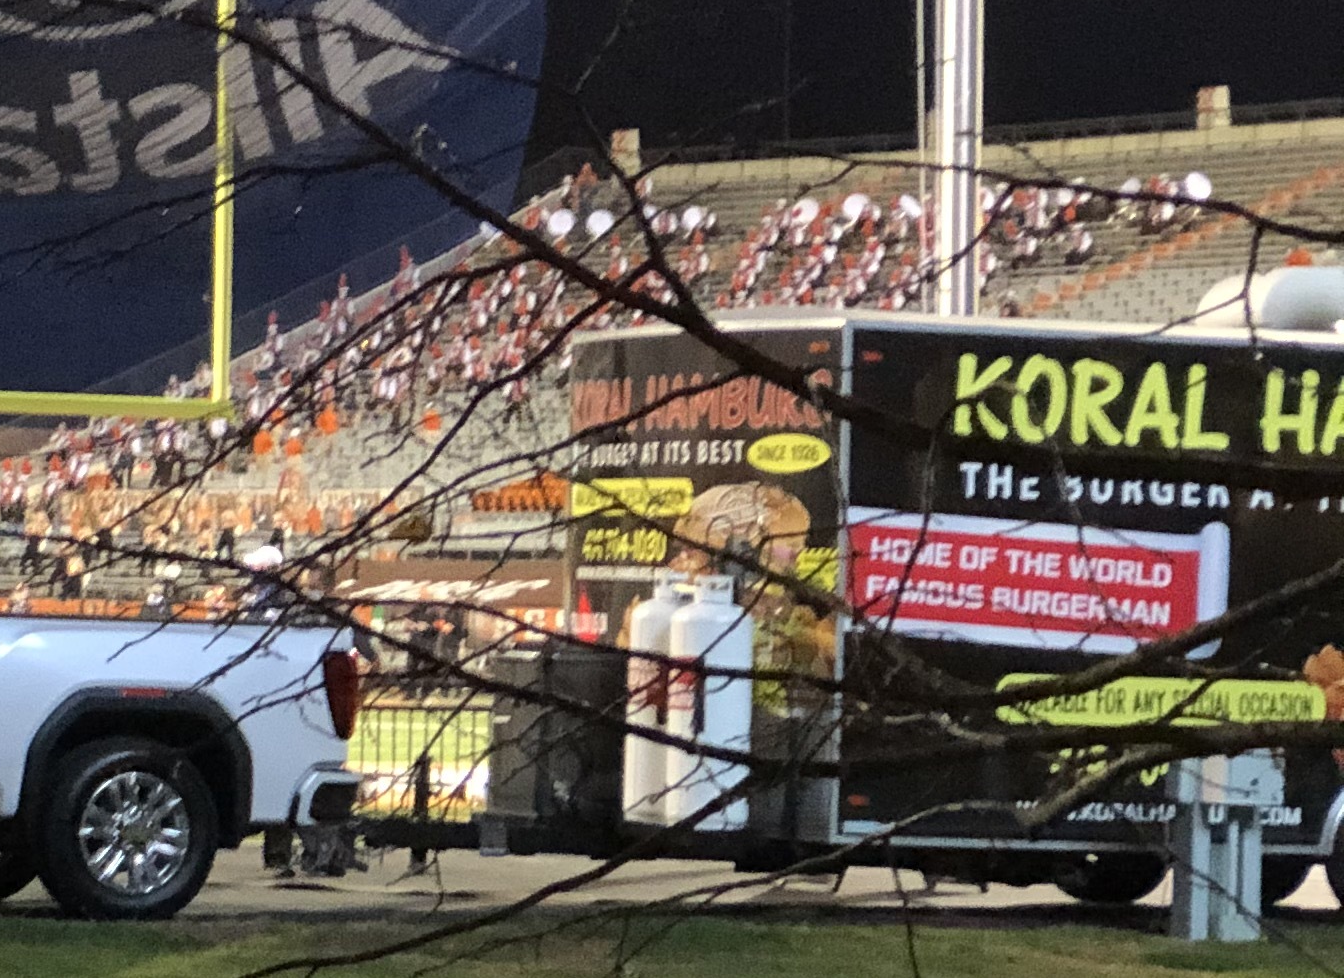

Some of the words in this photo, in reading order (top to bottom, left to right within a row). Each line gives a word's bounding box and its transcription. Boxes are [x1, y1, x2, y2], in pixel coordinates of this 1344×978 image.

[953, 353, 1230, 451] KORAL
[640, 442, 660, 467] AT
[663, 440, 691, 465] ITS
[696, 439, 748, 465] BEST
[960, 462, 1040, 502] THE
[871, 536, 951, 569] HOME
[962, 545, 999, 572] OF
[1004, 549, 1061, 579] THE
[1069, 557, 1173, 589] WORLD
[865, 574, 984, 610] FAMOUS
[992, 587, 1171, 627] BURGERMAN
[1096, 688, 1126, 714] FOR
[1132, 690, 1167, 716] ANY
